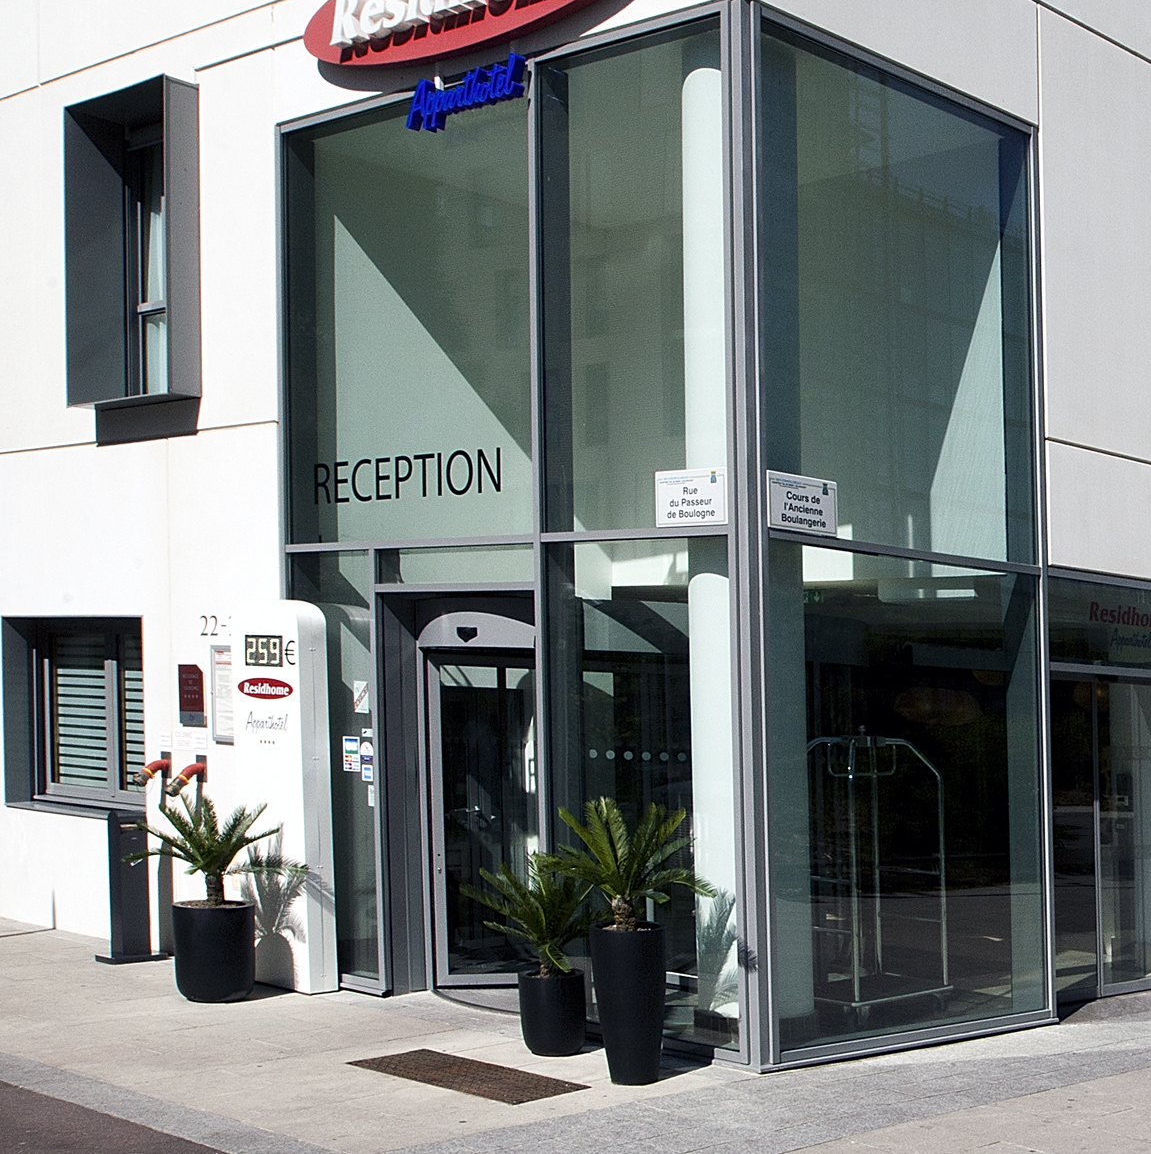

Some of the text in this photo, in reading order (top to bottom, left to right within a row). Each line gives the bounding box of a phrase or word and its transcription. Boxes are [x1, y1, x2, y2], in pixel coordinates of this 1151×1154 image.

[406, 52, 526, 133] Apparthotel
[313, 447, 502, 505] RECEPTION
[682, 486, 698, 496] Rue
[786, 491, 821, 505] Cours de
[669, 498, 712, 508] du Passeur
[783, 502, 823, 516] l'Ancienne
[667, 509, 716, 520] de Boulogne
[781, 513, 827, 528] Boulangerie
[200, 615, 231, 637] 22-
[246, 637, 296, 665] 259 €
[243, 681, 290, 696] Residhome
